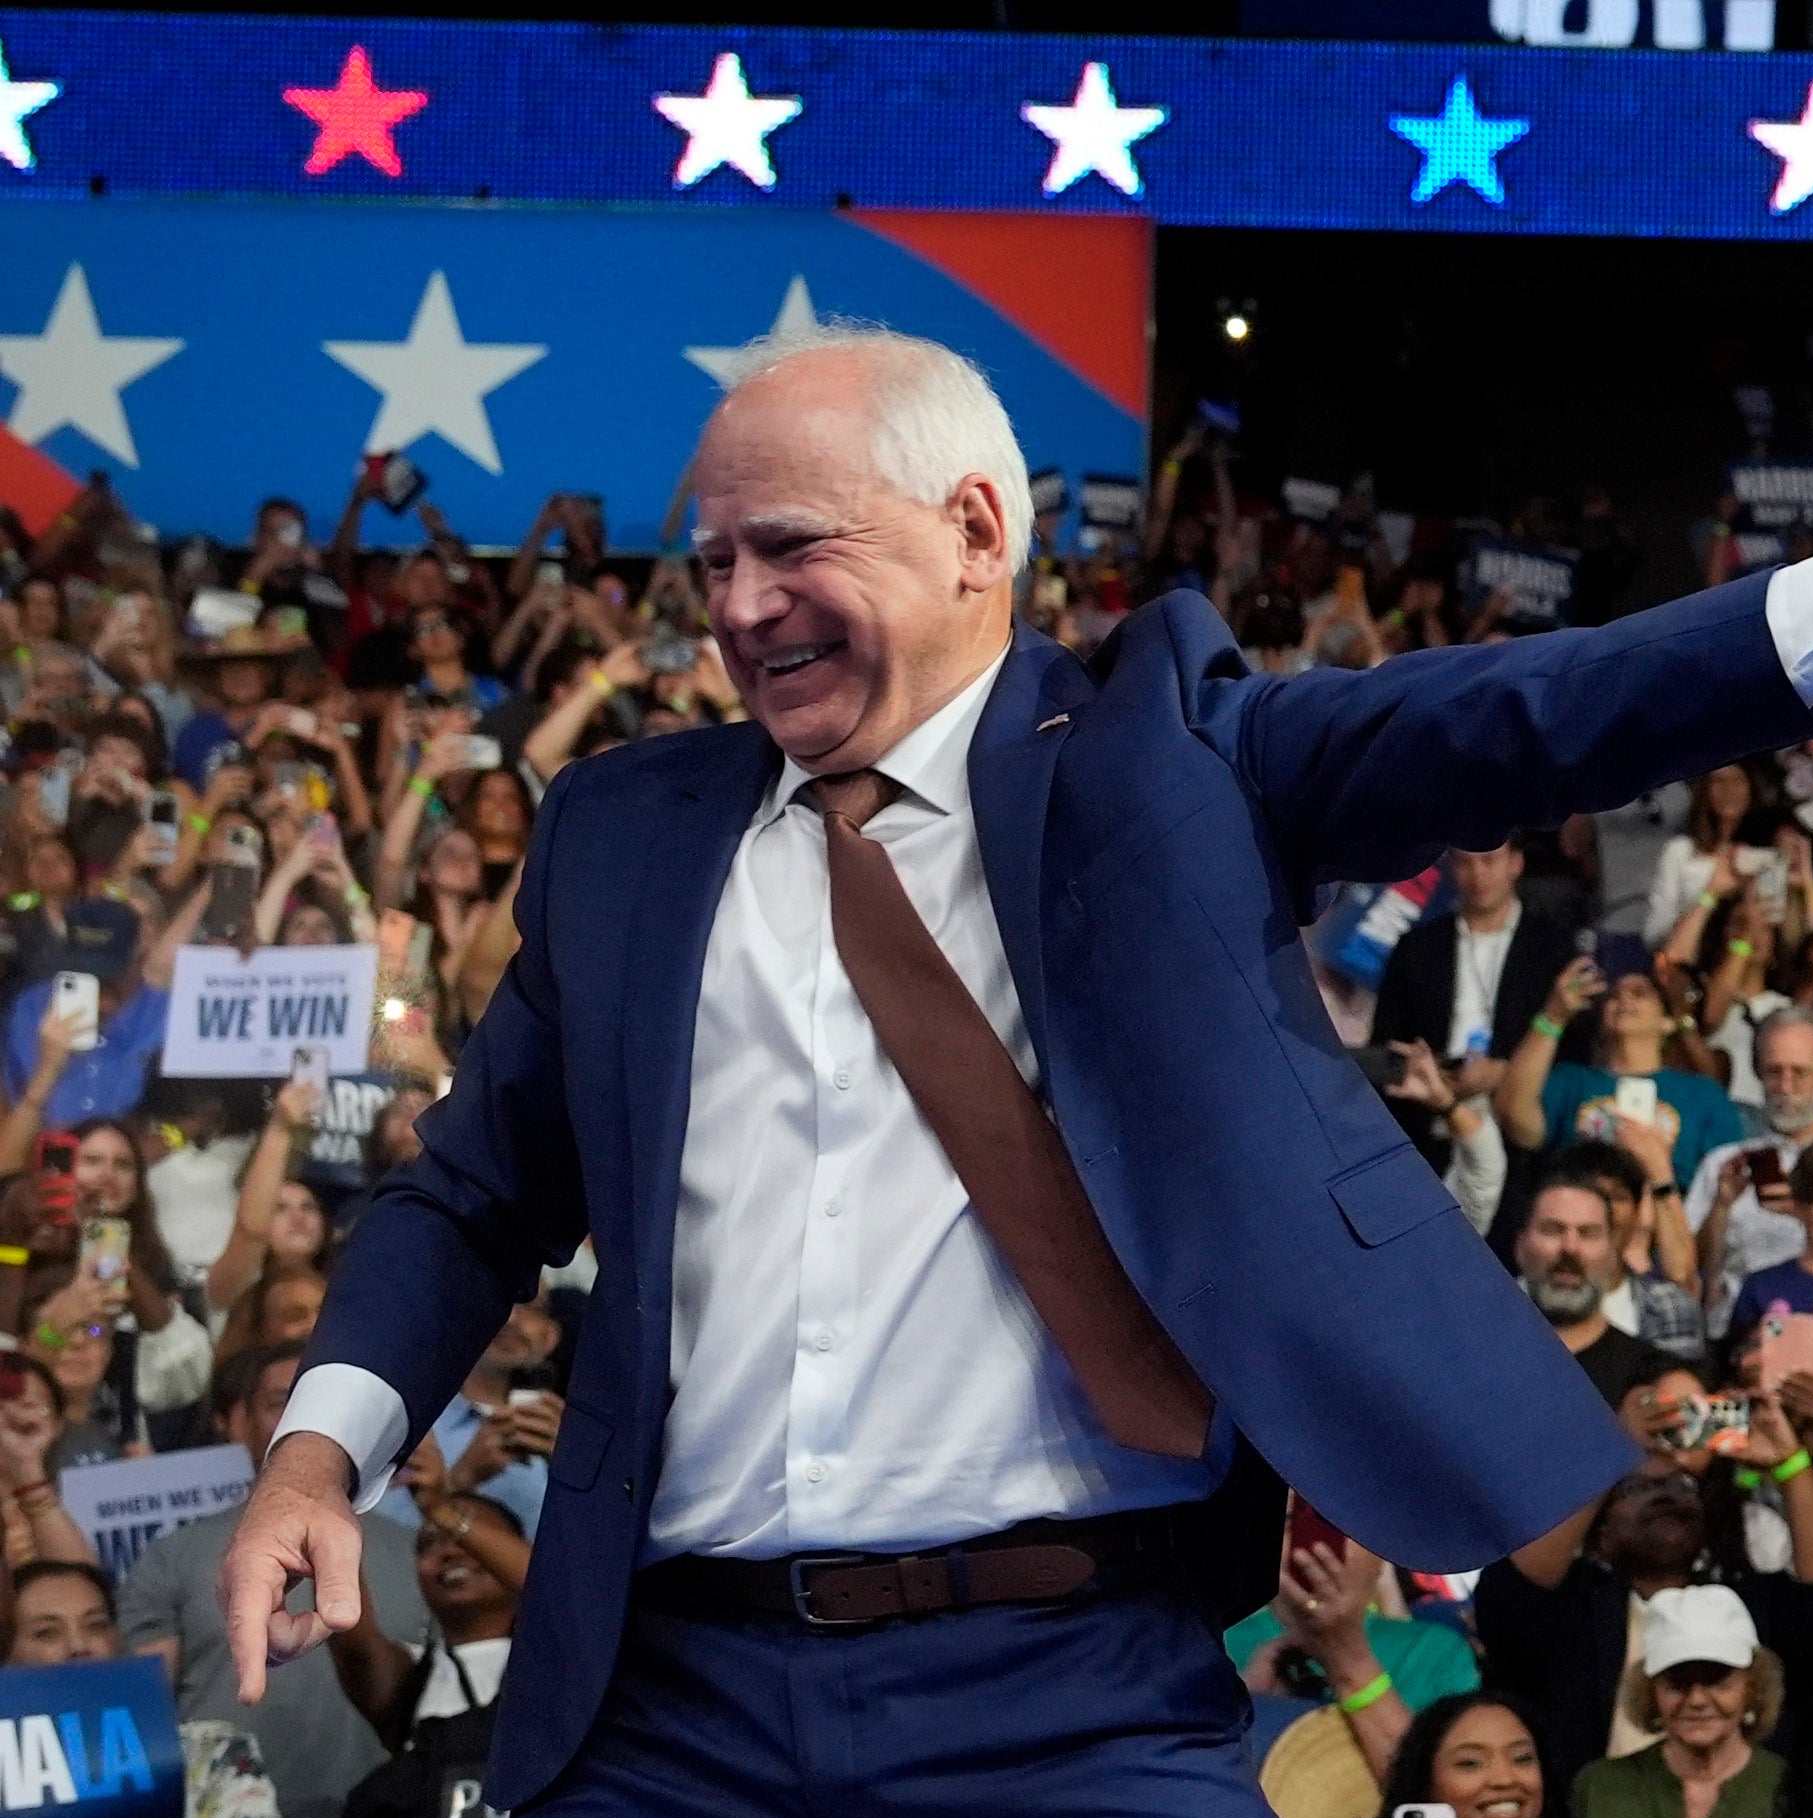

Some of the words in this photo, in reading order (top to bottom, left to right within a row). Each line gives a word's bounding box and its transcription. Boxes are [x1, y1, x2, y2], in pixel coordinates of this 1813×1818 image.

[198, 995, 256, 1040] WE
[269, 995, 348, 1038] WIN
[312, 1133, 364, 1165] WA
[98, 1495, 162, 1518] WHEN
[170, 1487, 202, 1508] WE
